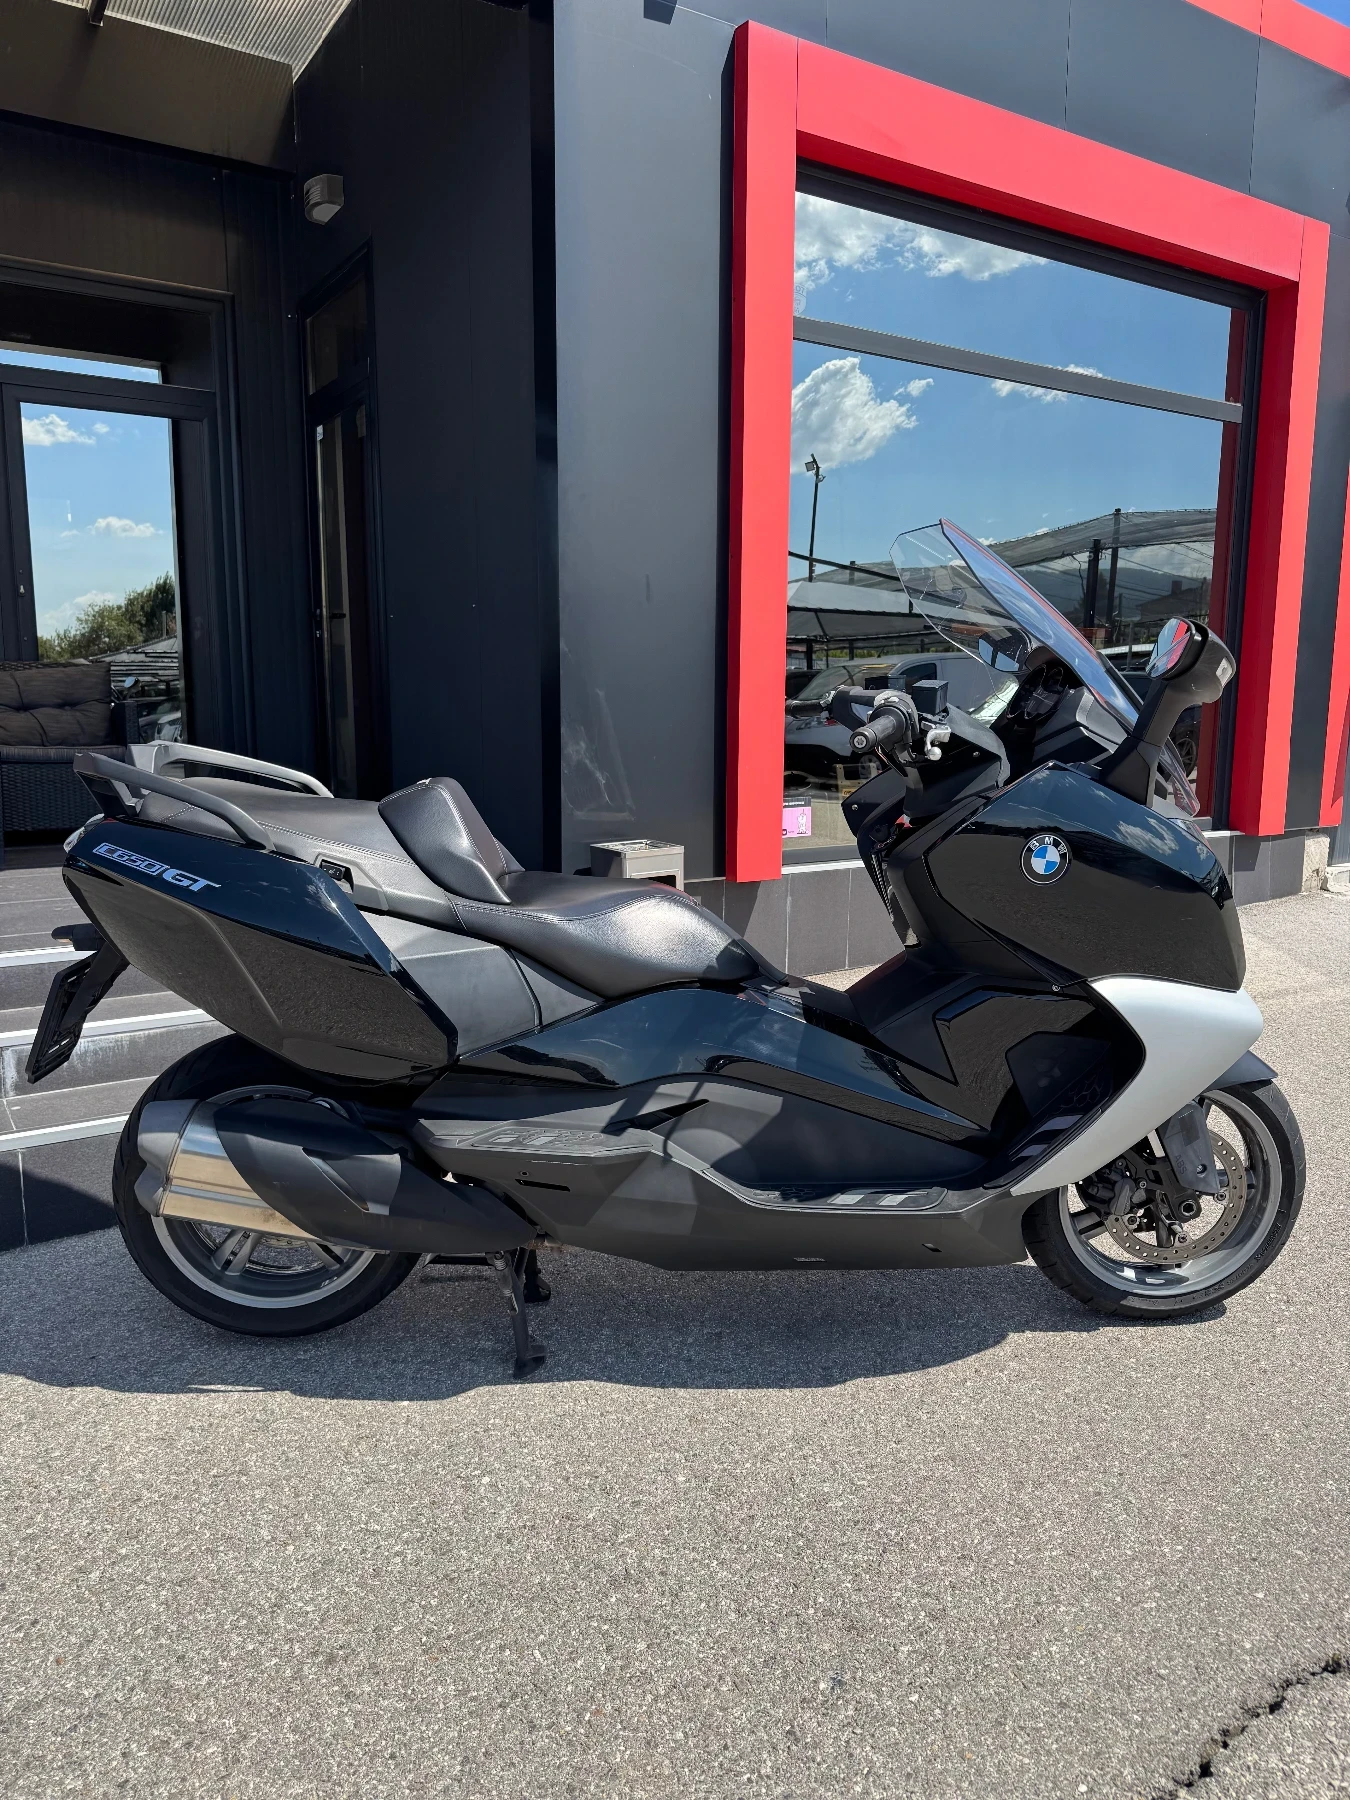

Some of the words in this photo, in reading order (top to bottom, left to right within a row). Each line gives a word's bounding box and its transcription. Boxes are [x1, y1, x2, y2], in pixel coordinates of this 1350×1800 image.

[1029, 836, 1067, 854] BMW
[95, 843, 166, 875] C650
[163, 868, 221, 891] GT
[1174, 1154, 1188, 1175] ABS
